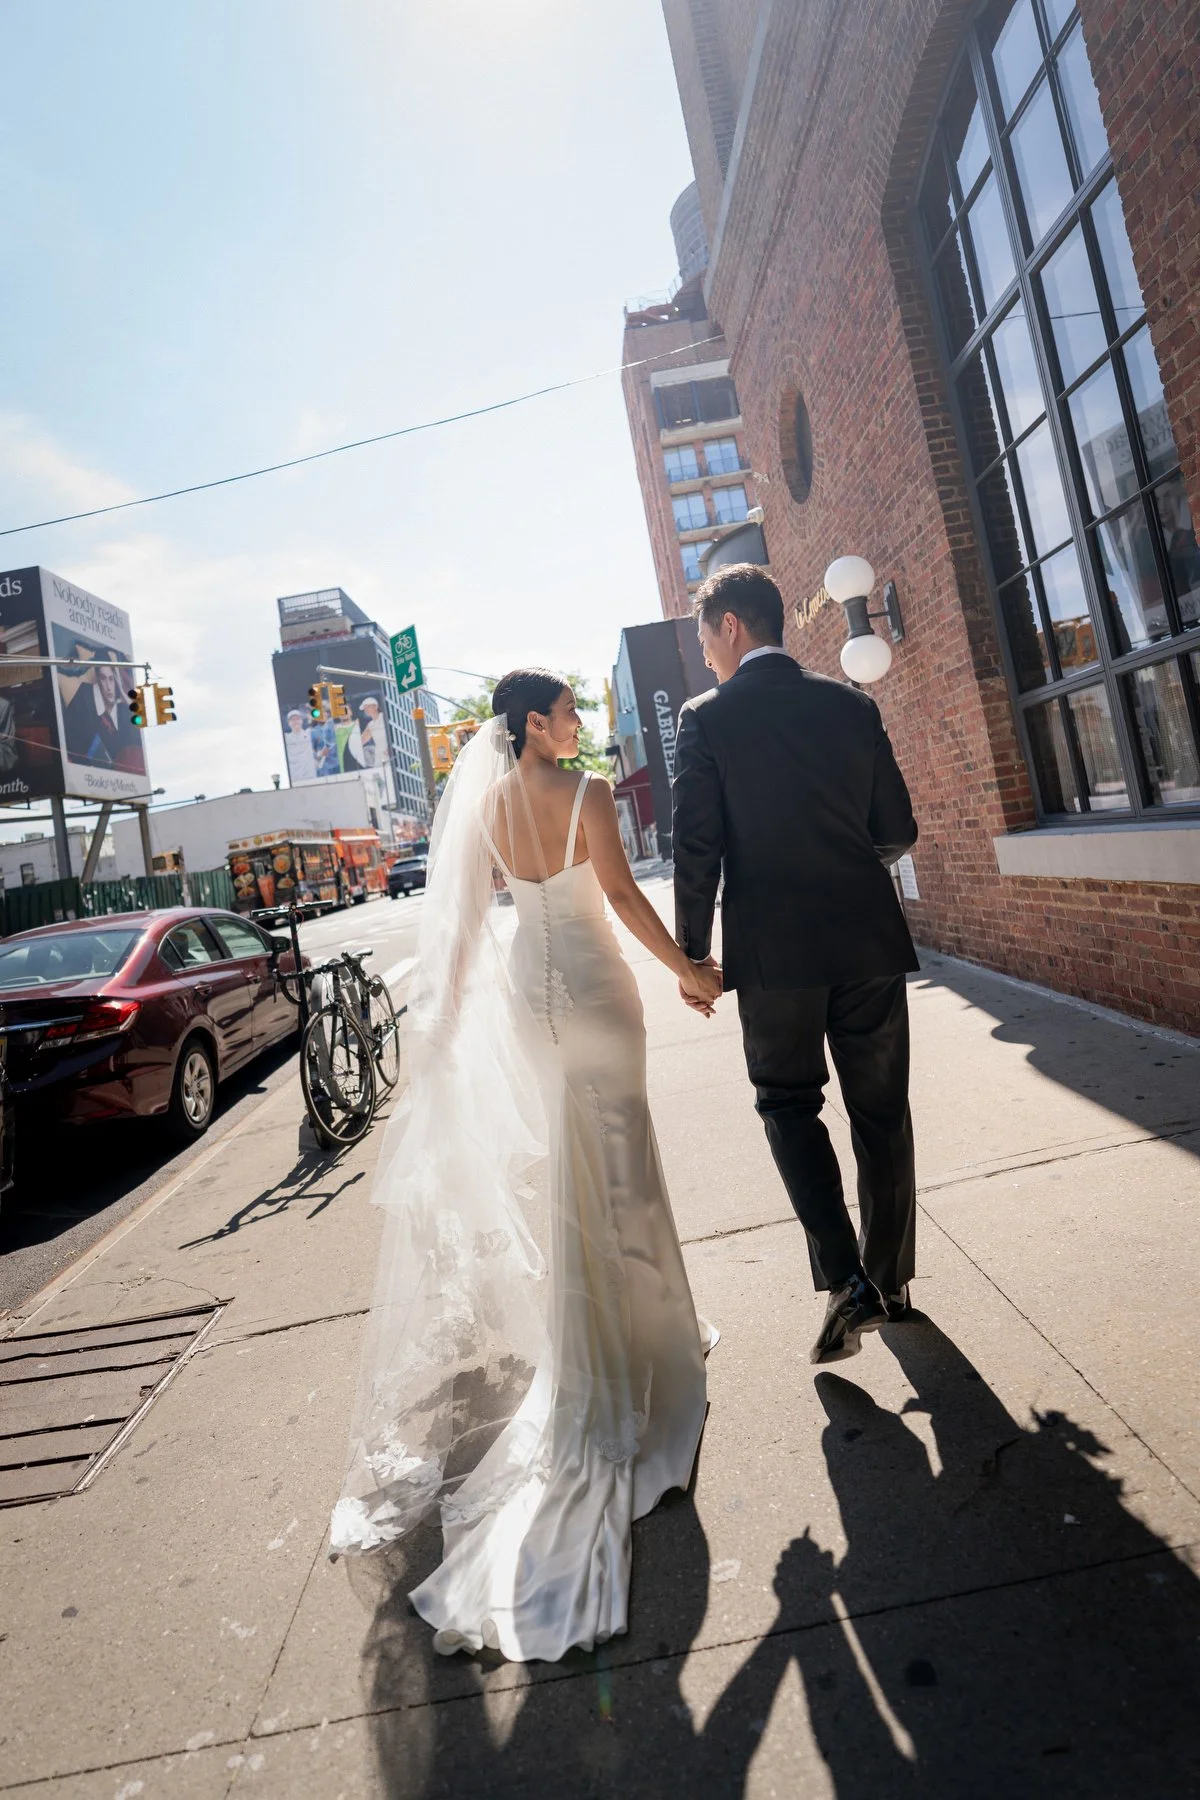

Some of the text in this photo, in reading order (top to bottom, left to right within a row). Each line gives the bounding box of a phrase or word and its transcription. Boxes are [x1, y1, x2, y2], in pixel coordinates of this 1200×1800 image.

[52, 580, 124, 629] Nobody reads
[68, 607, 116, 641] anymore.
